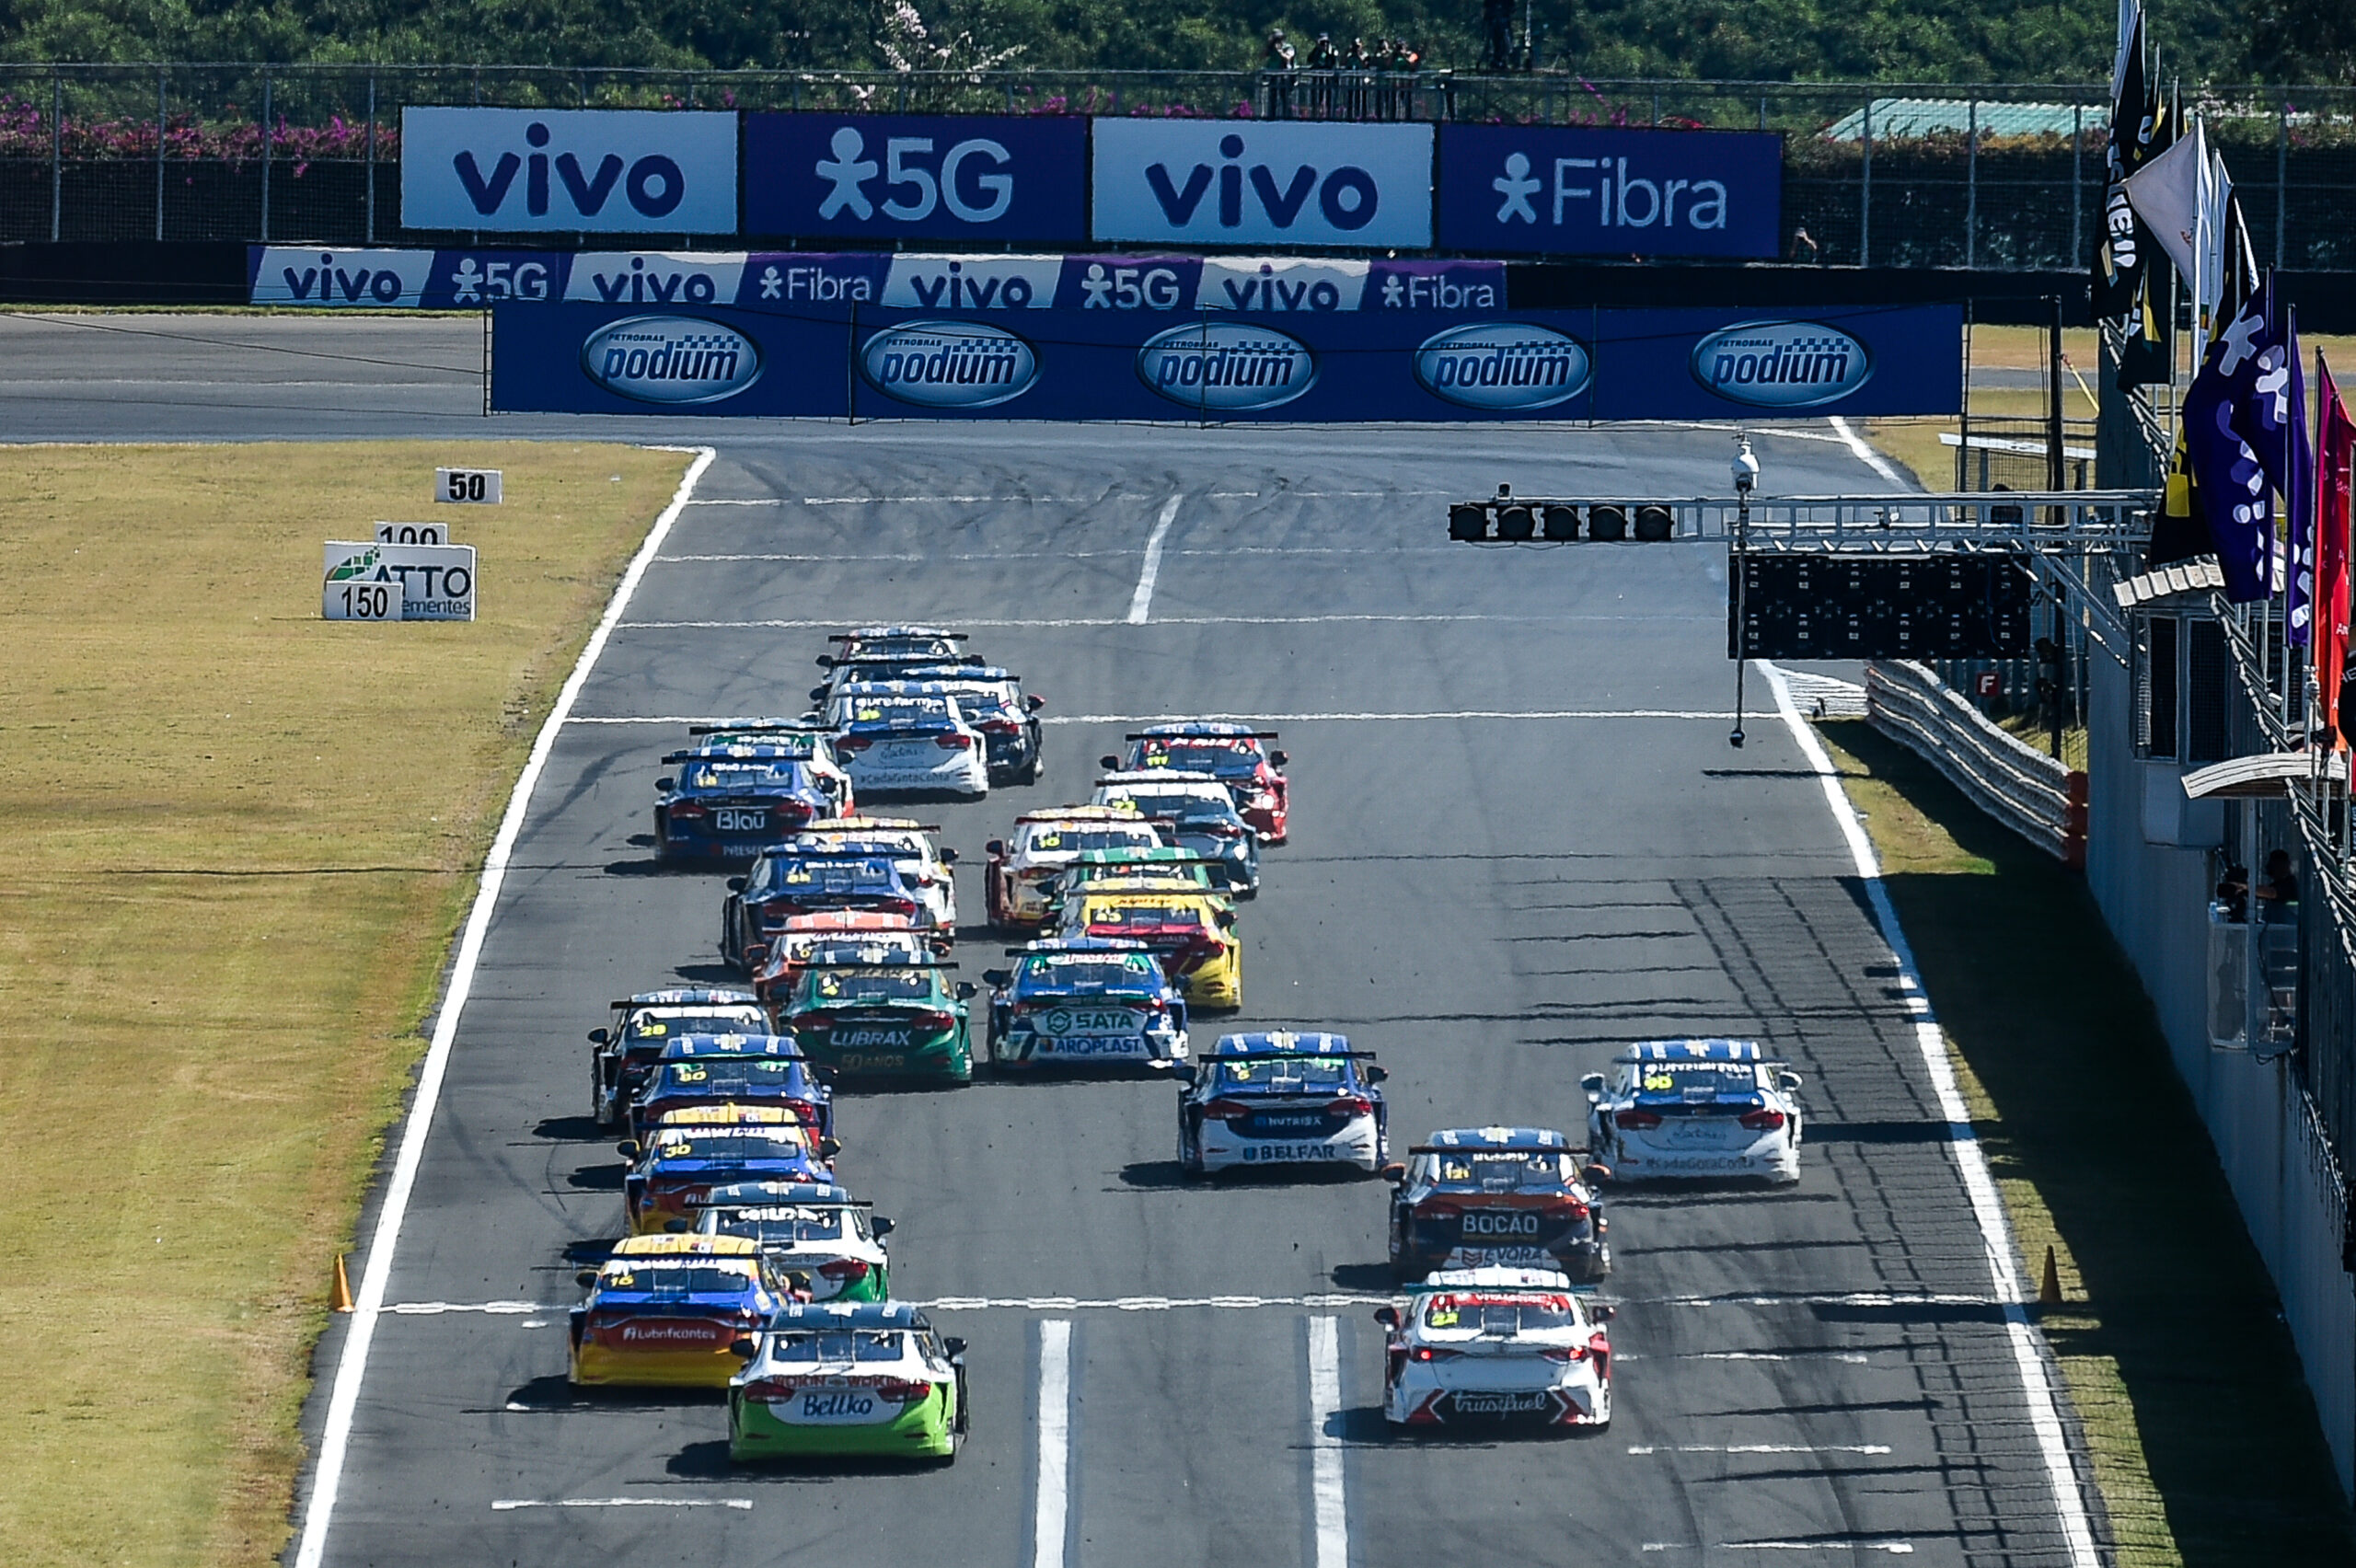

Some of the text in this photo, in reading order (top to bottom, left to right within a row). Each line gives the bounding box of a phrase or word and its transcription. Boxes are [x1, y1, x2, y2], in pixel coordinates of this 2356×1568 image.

[453, 122, 685, 219] vivo
[880, 137, 1013, 224] 5G
[1144, 133, 1379, 232] vivo
[1552, 156, 1727, 230] Fibra
[283, 253, 403, 303] vivo
[485, 262, 549, 302] 5G
[592, 256, 716, 303] vivo
[787, 268, 872, 302] Fibra
[909, 260, 1034, 309] vivo
[1114, 268, 1180, 310] 5G
[1222, 262, 1340, 311] vivo
[1409, 275, 1496, 309] Fibra
[607, 333, 665, 342] PETROBRAS
[885, 339, 942, 347] PETROBRAS
[1716, 339, 1774, 347] PETROBRAS
[600, 340, 739, 384] podium
[879, 345, 1017, 388] podium
[1156, 347, 1294, 390] podium
[1432, 347, 1570, 392] podium
[1711, 344, 1849, 388] podium
[447, 473, 486, 502] 50
[379, 525, 439, 546] 100
[341, 586, 389, 619] 150
[401, 599, 471, 616] ementes
[1980, 674, 1995, 694] F
[1075, 1012, 1135, 1029] SATA
[829, 1029, 912, 1047] LUBRAX
[1644, 1075, 1673, 1090] 90
[664, 1144, 692, 1159] 30
[1260, 1144, 1335, 1160] BELFAR
[610, 1275, 635, 1287] 16
[802, 1395, 873, 1418] Bellko
